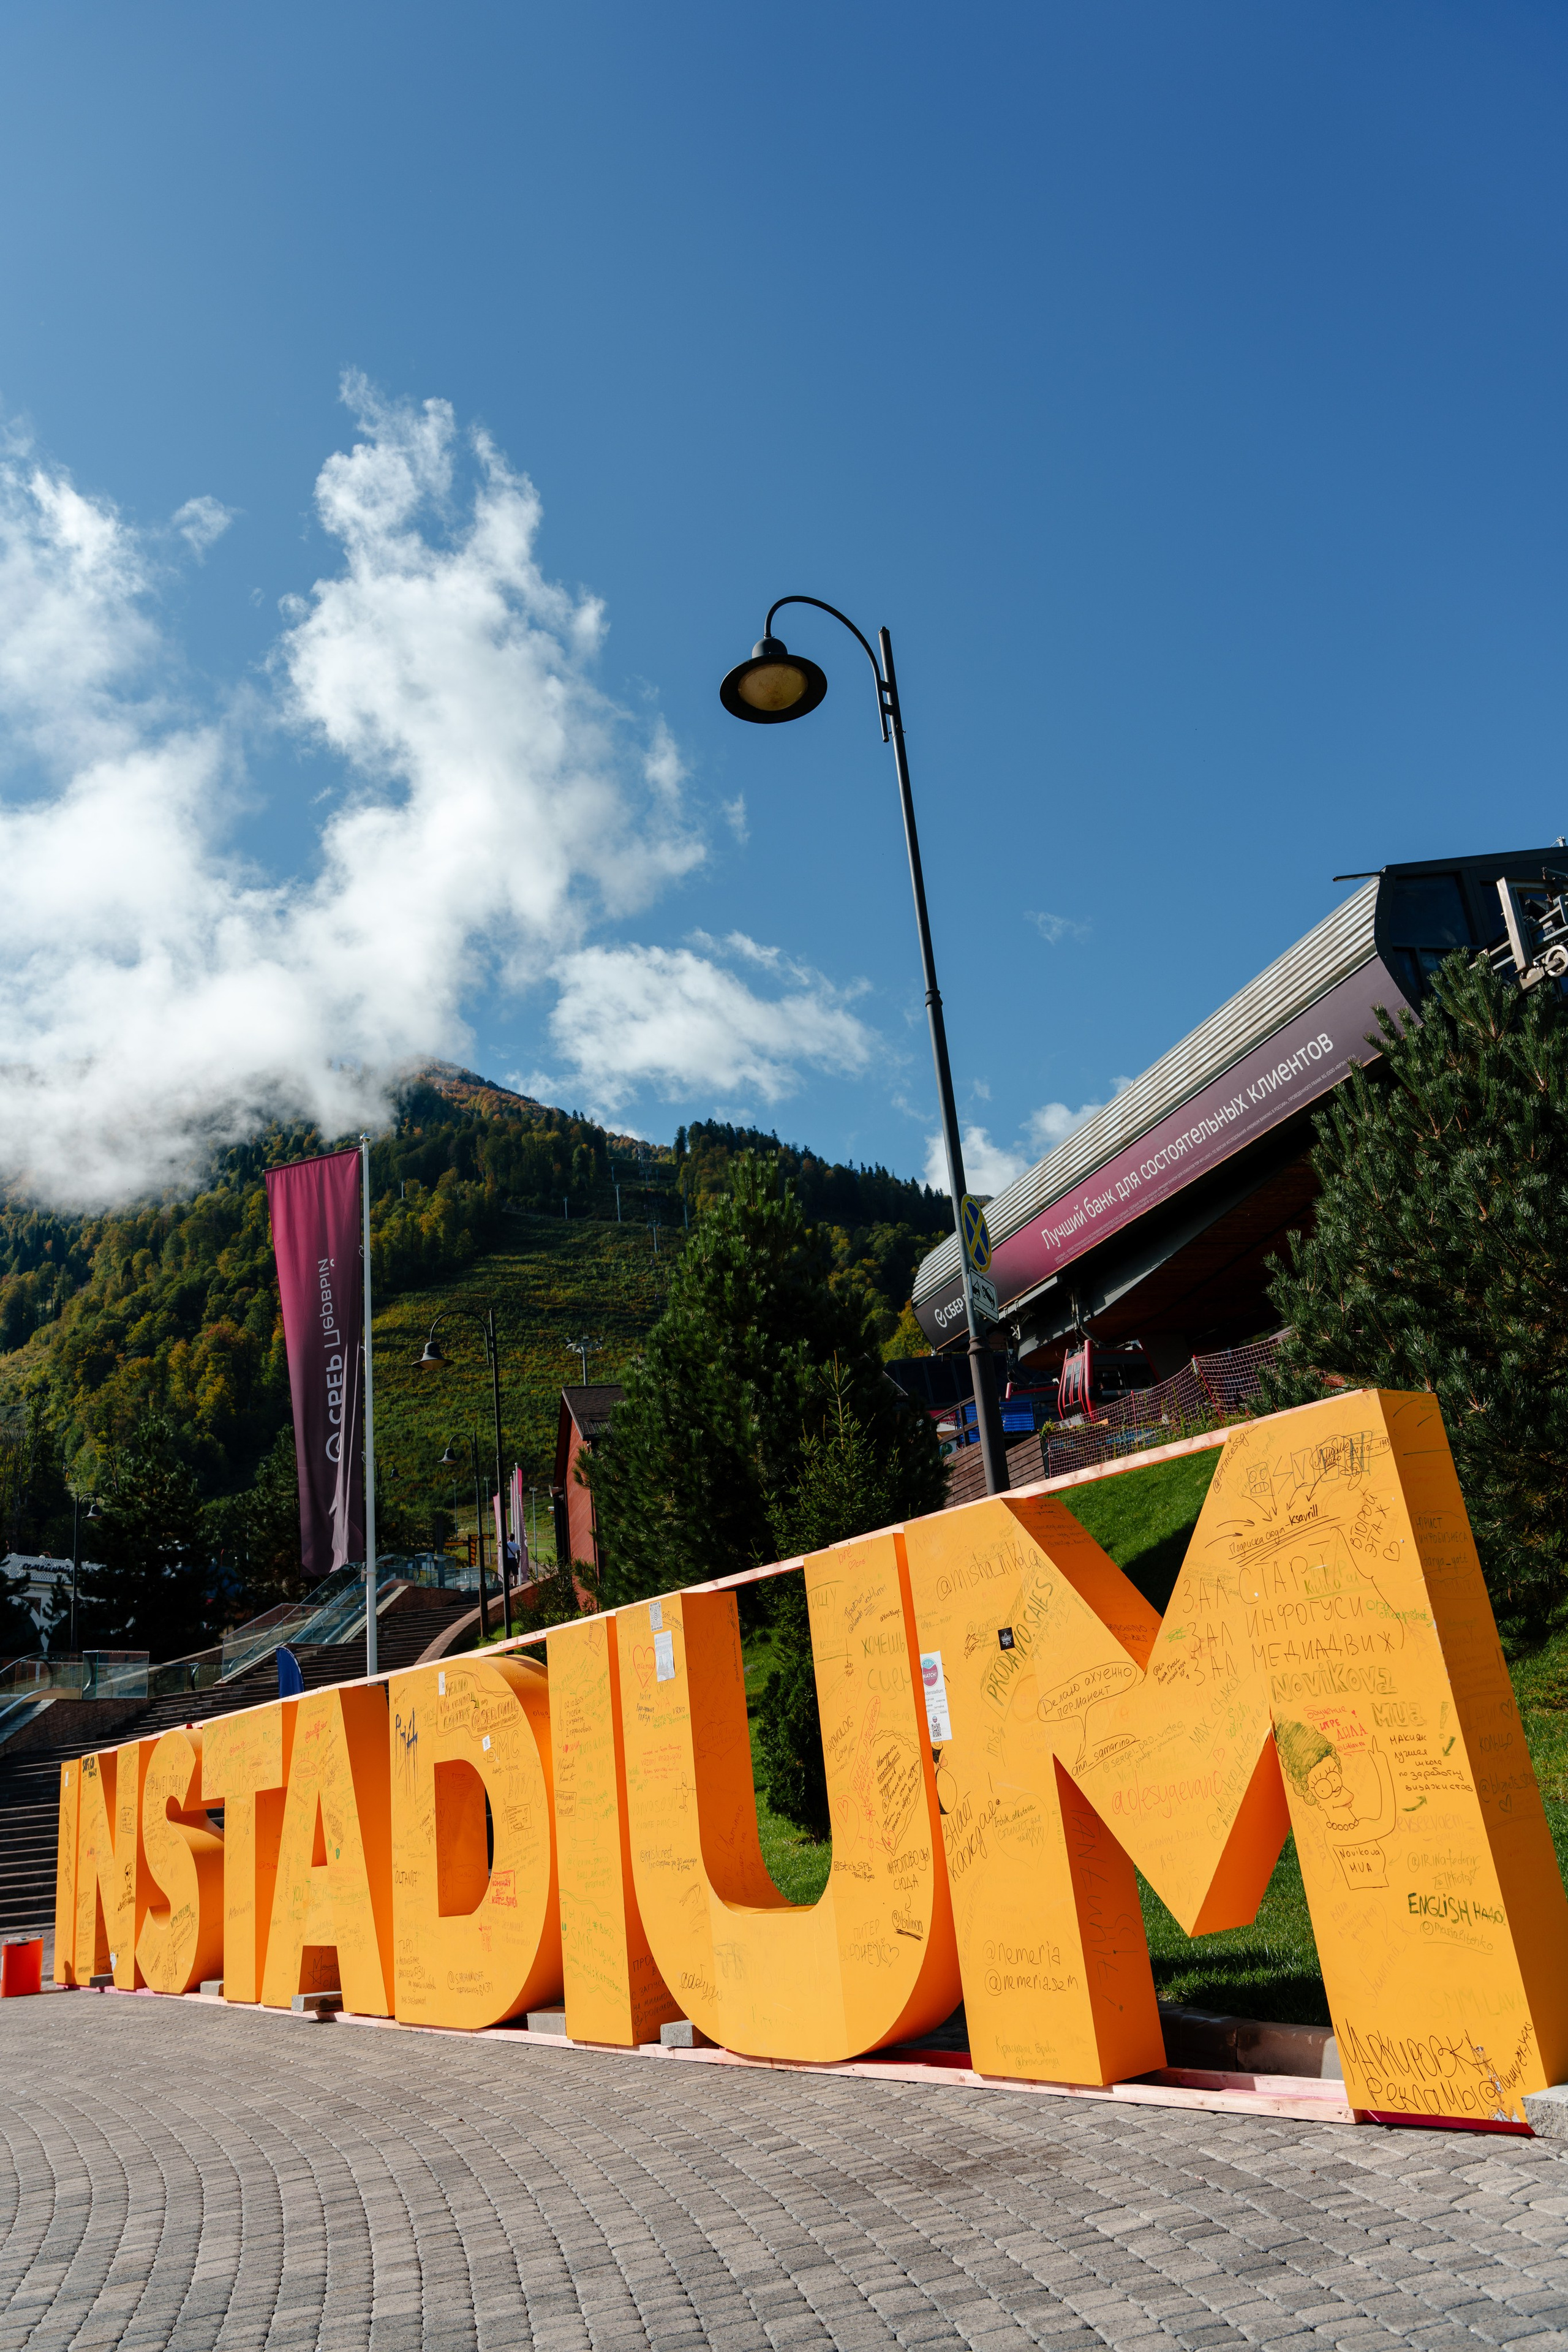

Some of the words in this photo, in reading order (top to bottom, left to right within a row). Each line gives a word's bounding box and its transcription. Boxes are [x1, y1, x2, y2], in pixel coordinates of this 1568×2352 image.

[1041, 1204, 1088, 1250] Лучший
[1084, 1189, 1118, 1218] банк
[1115, 1170, 1140, 1202] для
[1140, 1094, 1250, 1180] состоятельных
[1246, 1033, 1333, 1104] клиентов
[944, 1297, 963, 1319] СБЕР
[1183, 1577, 1229, 1613] ЗАЛ
[861, 1632, 905, 1659] ХОЧЕШЬ
[1187, 1621, 1233, 1653] ЗАЛ
[1191, 1651, 1236, 1686] ЗАЛ
[53, 1388, 1553, 2123] INSTADIUM
[1408, 1892, 1473, 1927] ENGLISH
